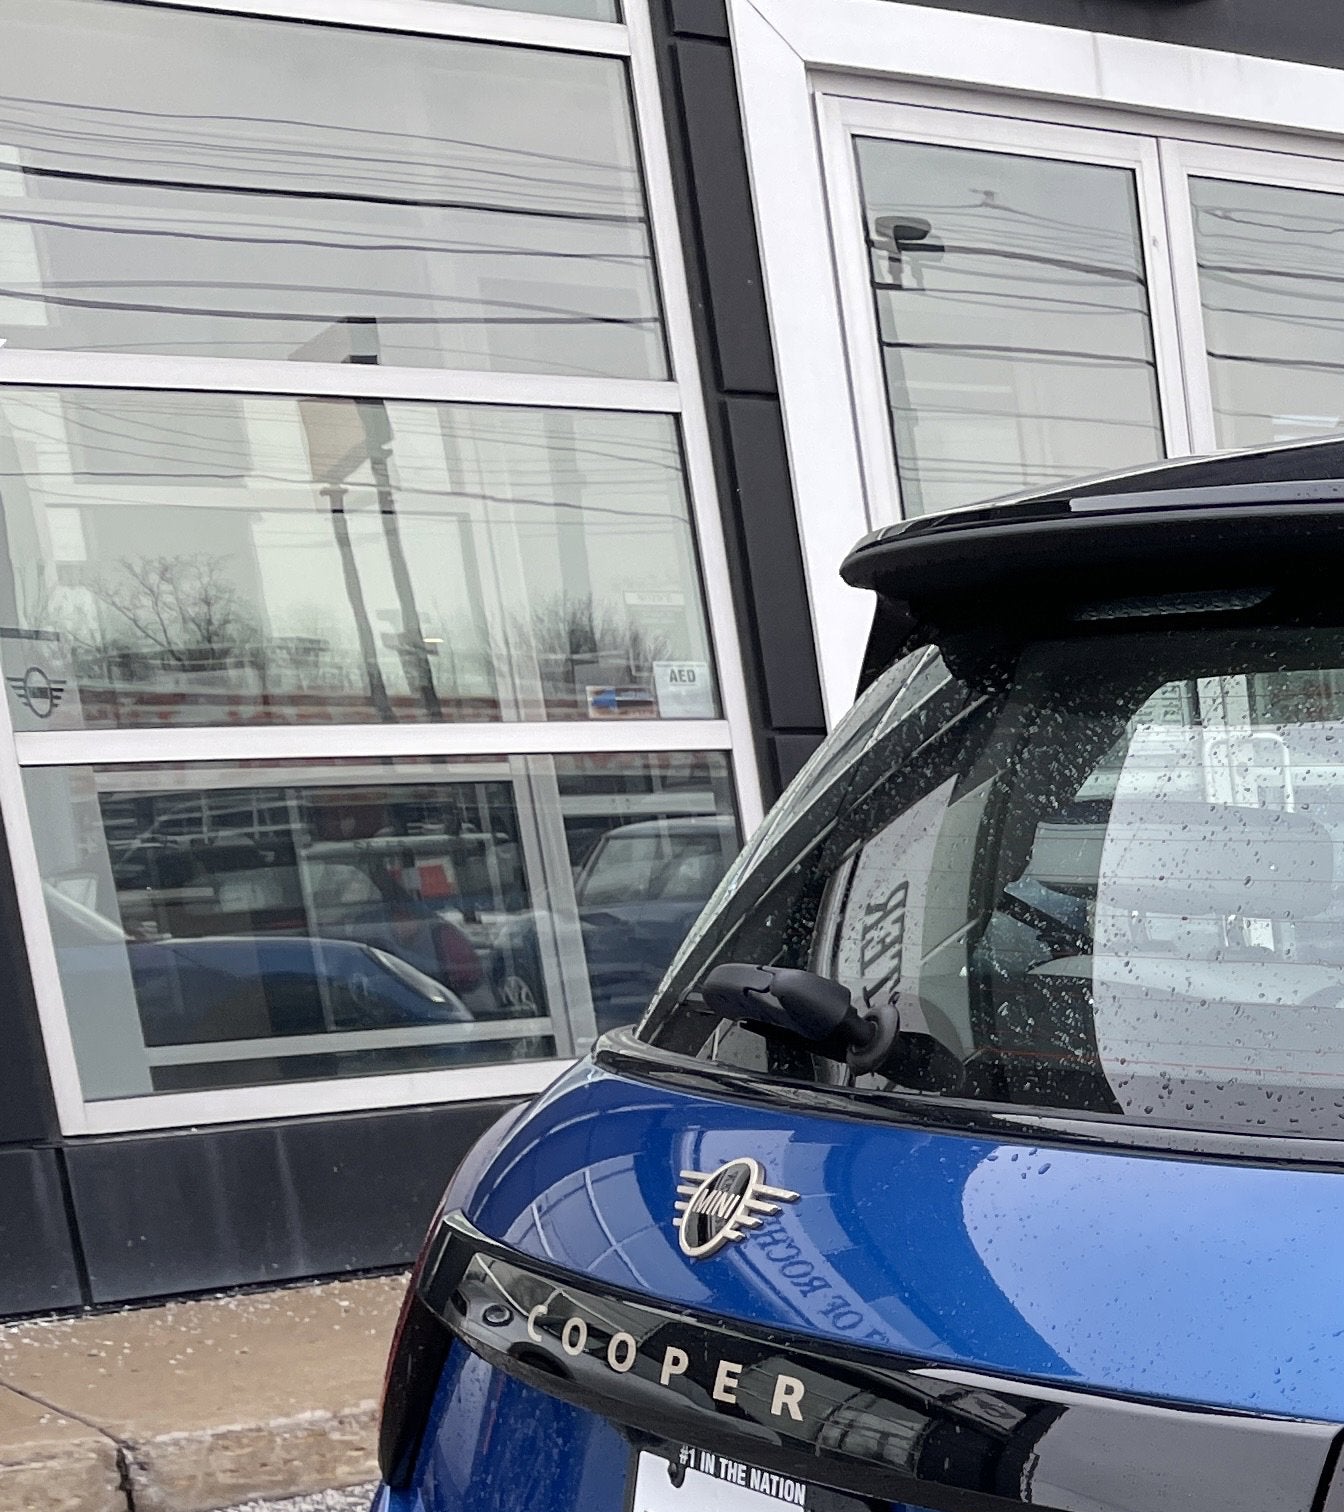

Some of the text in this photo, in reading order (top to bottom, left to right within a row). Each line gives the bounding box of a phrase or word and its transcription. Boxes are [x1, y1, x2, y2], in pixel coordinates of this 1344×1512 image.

[669, 669, 696, 682] AED
[692, 1188, 741, 1219] MINI
[526, 1304, 805, 1421] COOPER
[679, 1446, 806, 1506] #1 IN THE NATION
